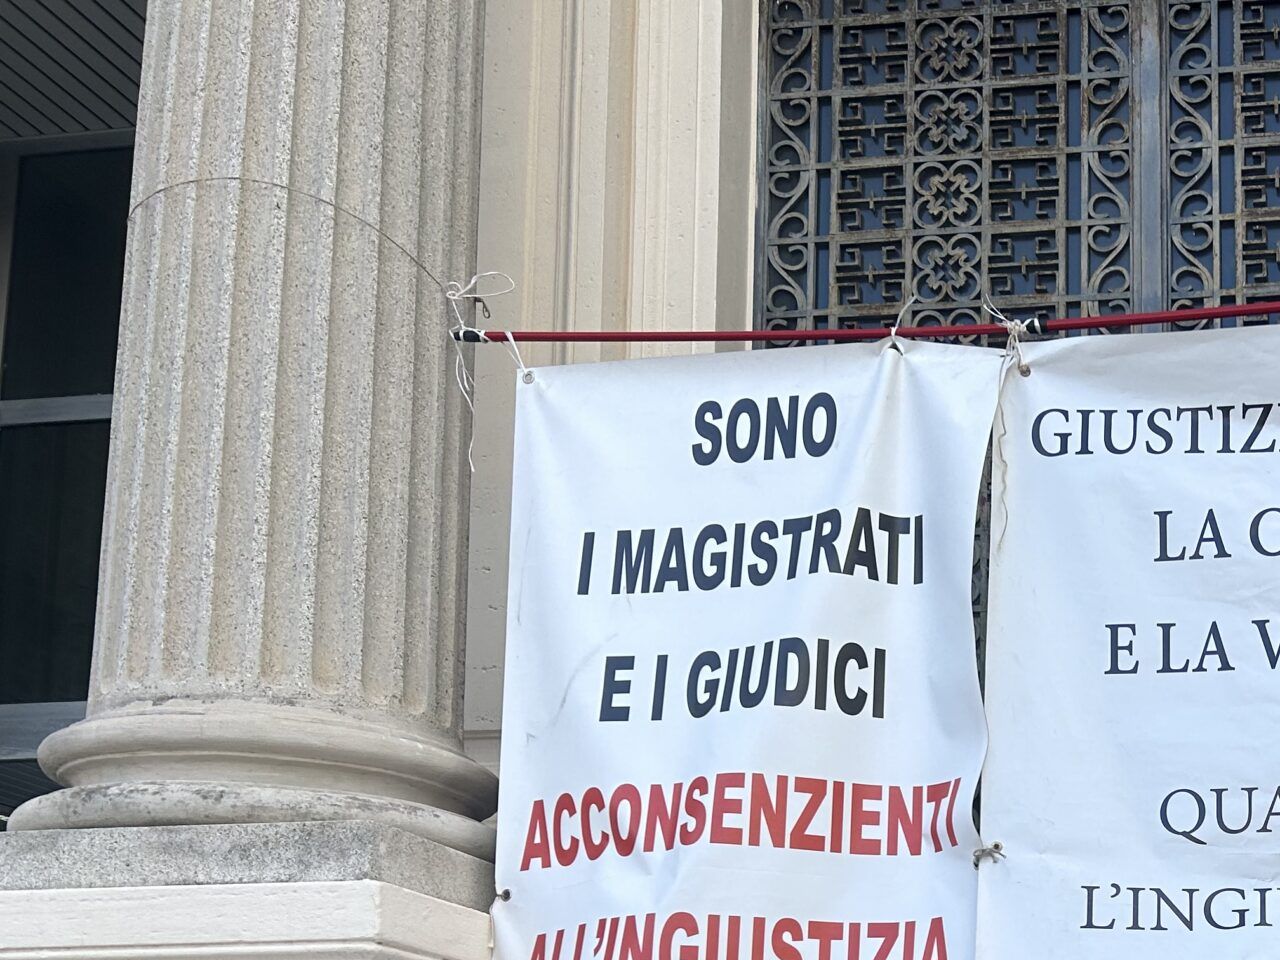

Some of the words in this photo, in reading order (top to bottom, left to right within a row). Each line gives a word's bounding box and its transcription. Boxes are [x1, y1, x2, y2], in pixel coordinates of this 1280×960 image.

[691, 392, 838, 466] SONO
[577, 531, 596, 596] I
[611, 506, 924, 595] MAGISTRATI
[1153, 508, 1232, 562] LA
[598, 655, 636, 722] E
[650, 654, 669, 721] I
[686, 636, 887, 719] GIUDICI
[1104, 623, 1140, 675] E
[1156, 620, 1236, 674] LA
[519, 772, 962, 872] ACCONSENZIENTI
